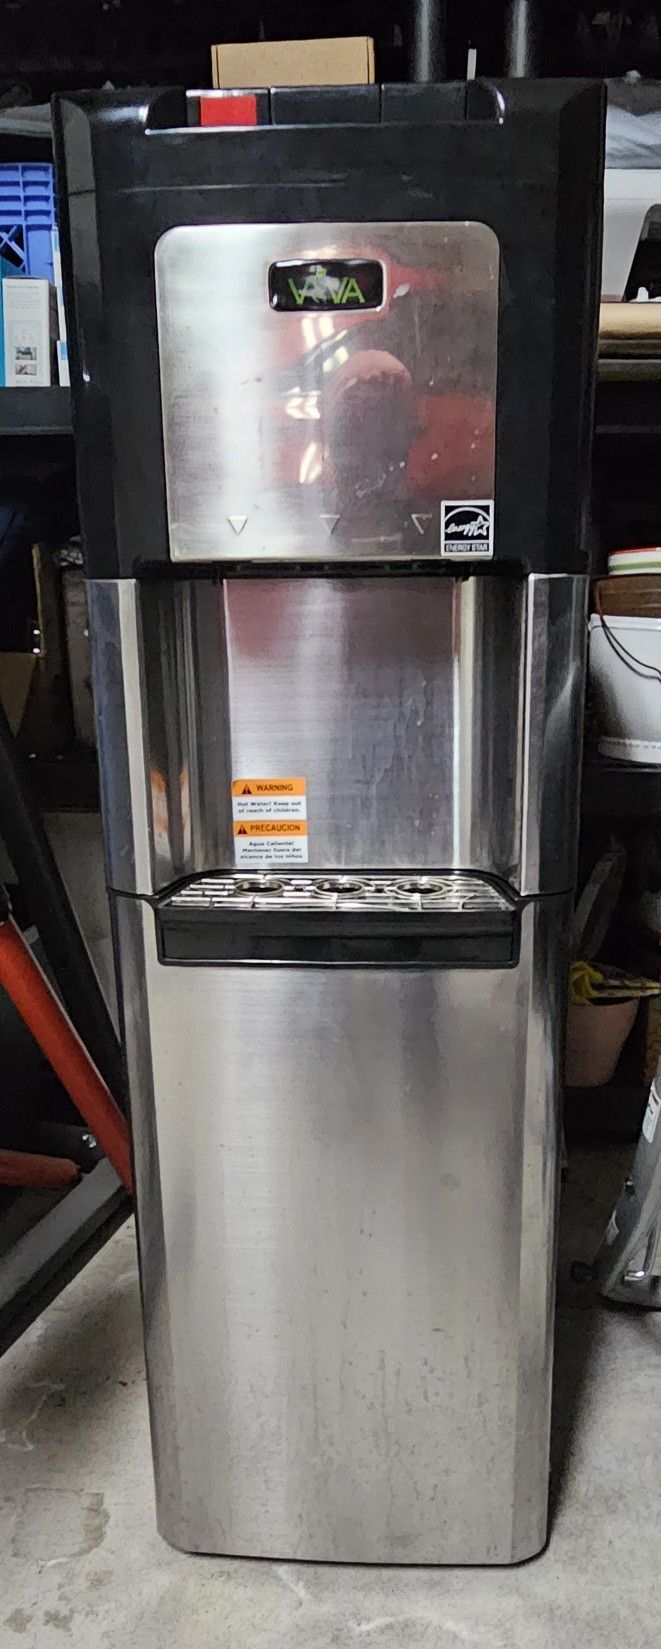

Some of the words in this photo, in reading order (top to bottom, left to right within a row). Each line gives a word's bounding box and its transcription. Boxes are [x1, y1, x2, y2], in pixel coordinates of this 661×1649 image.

[445, 543, 470, 552] ENERGY
[471, 543, 488, 551] STAR
[256, 784, 294, 792] WARNING
